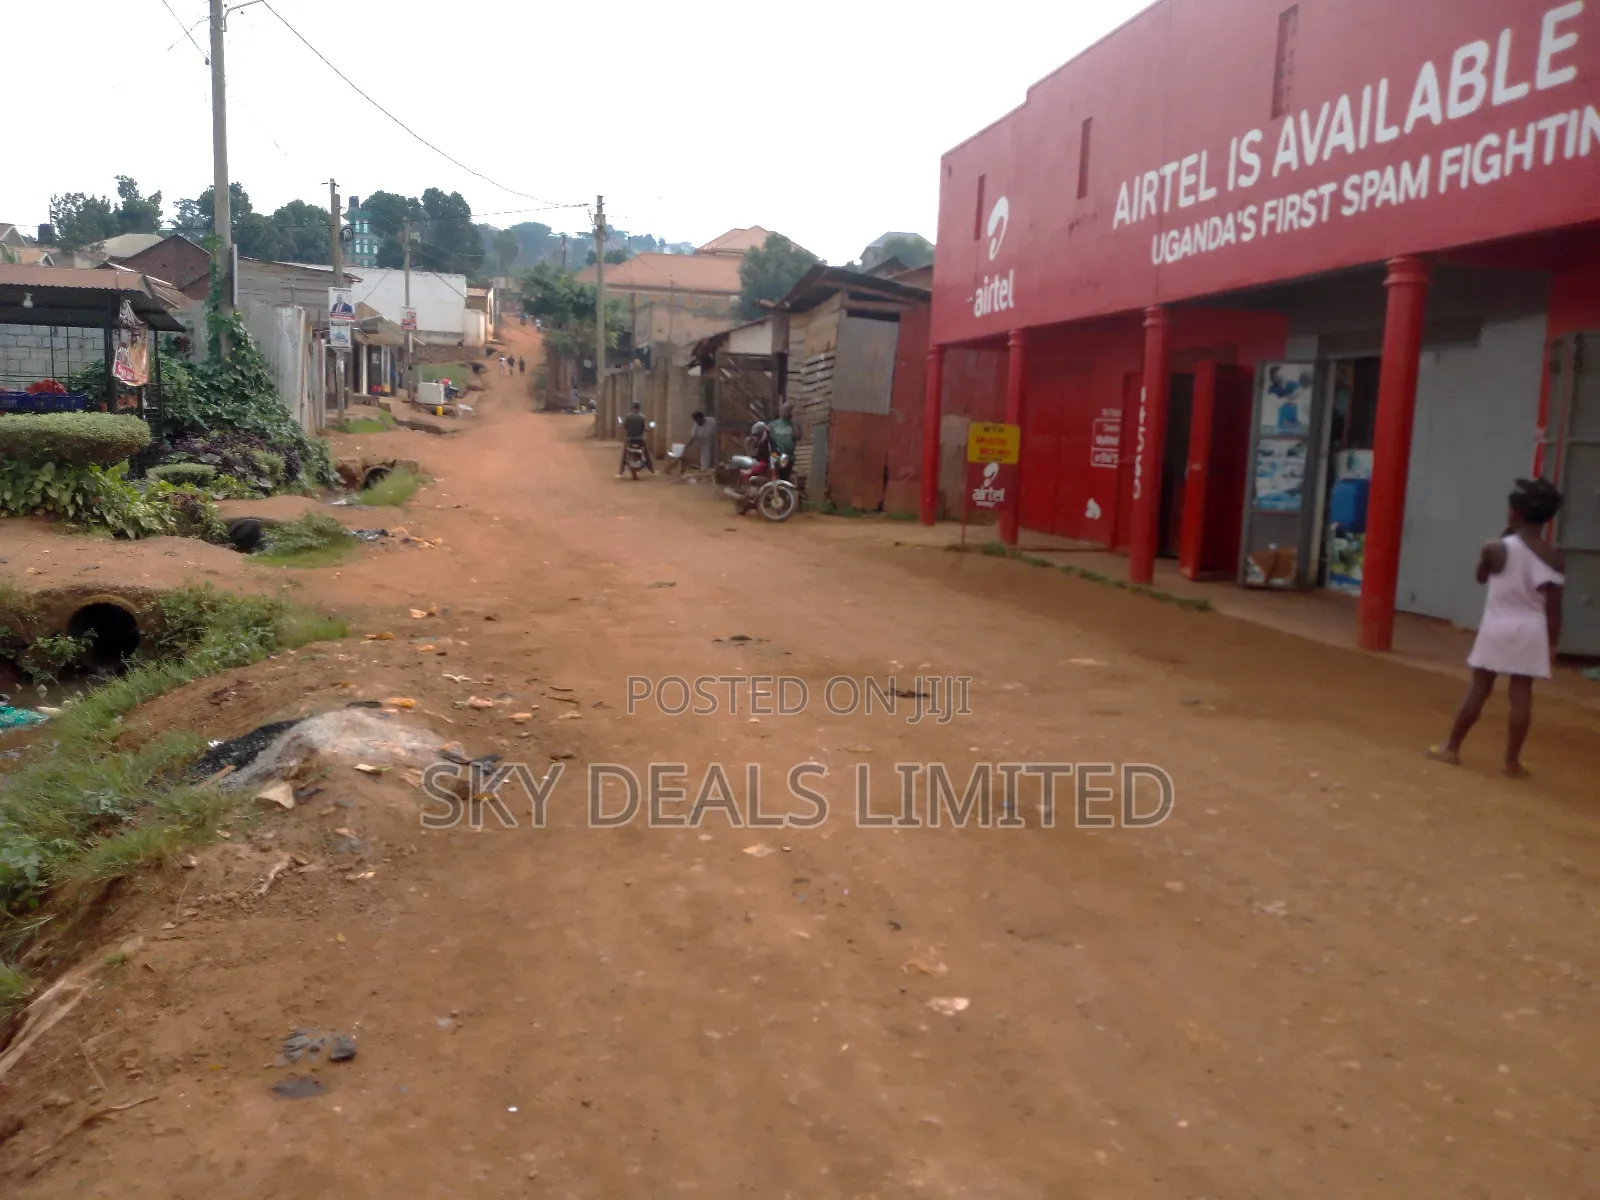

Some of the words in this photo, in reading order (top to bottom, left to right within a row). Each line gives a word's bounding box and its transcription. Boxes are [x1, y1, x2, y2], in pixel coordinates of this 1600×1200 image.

[1113, 149, 1217, 230] AIRTEL
[1227, 128, 1263, 191] IS
[1272, 0, 1584, 178] AVAILABLE
[1152, 204, 1258, 266] UGANDA'S
[1261, 182, 1338, 237] FIRST
[1340, 154, 1430, 216] SPAM
[973, 268, 1014, 319] airtel
